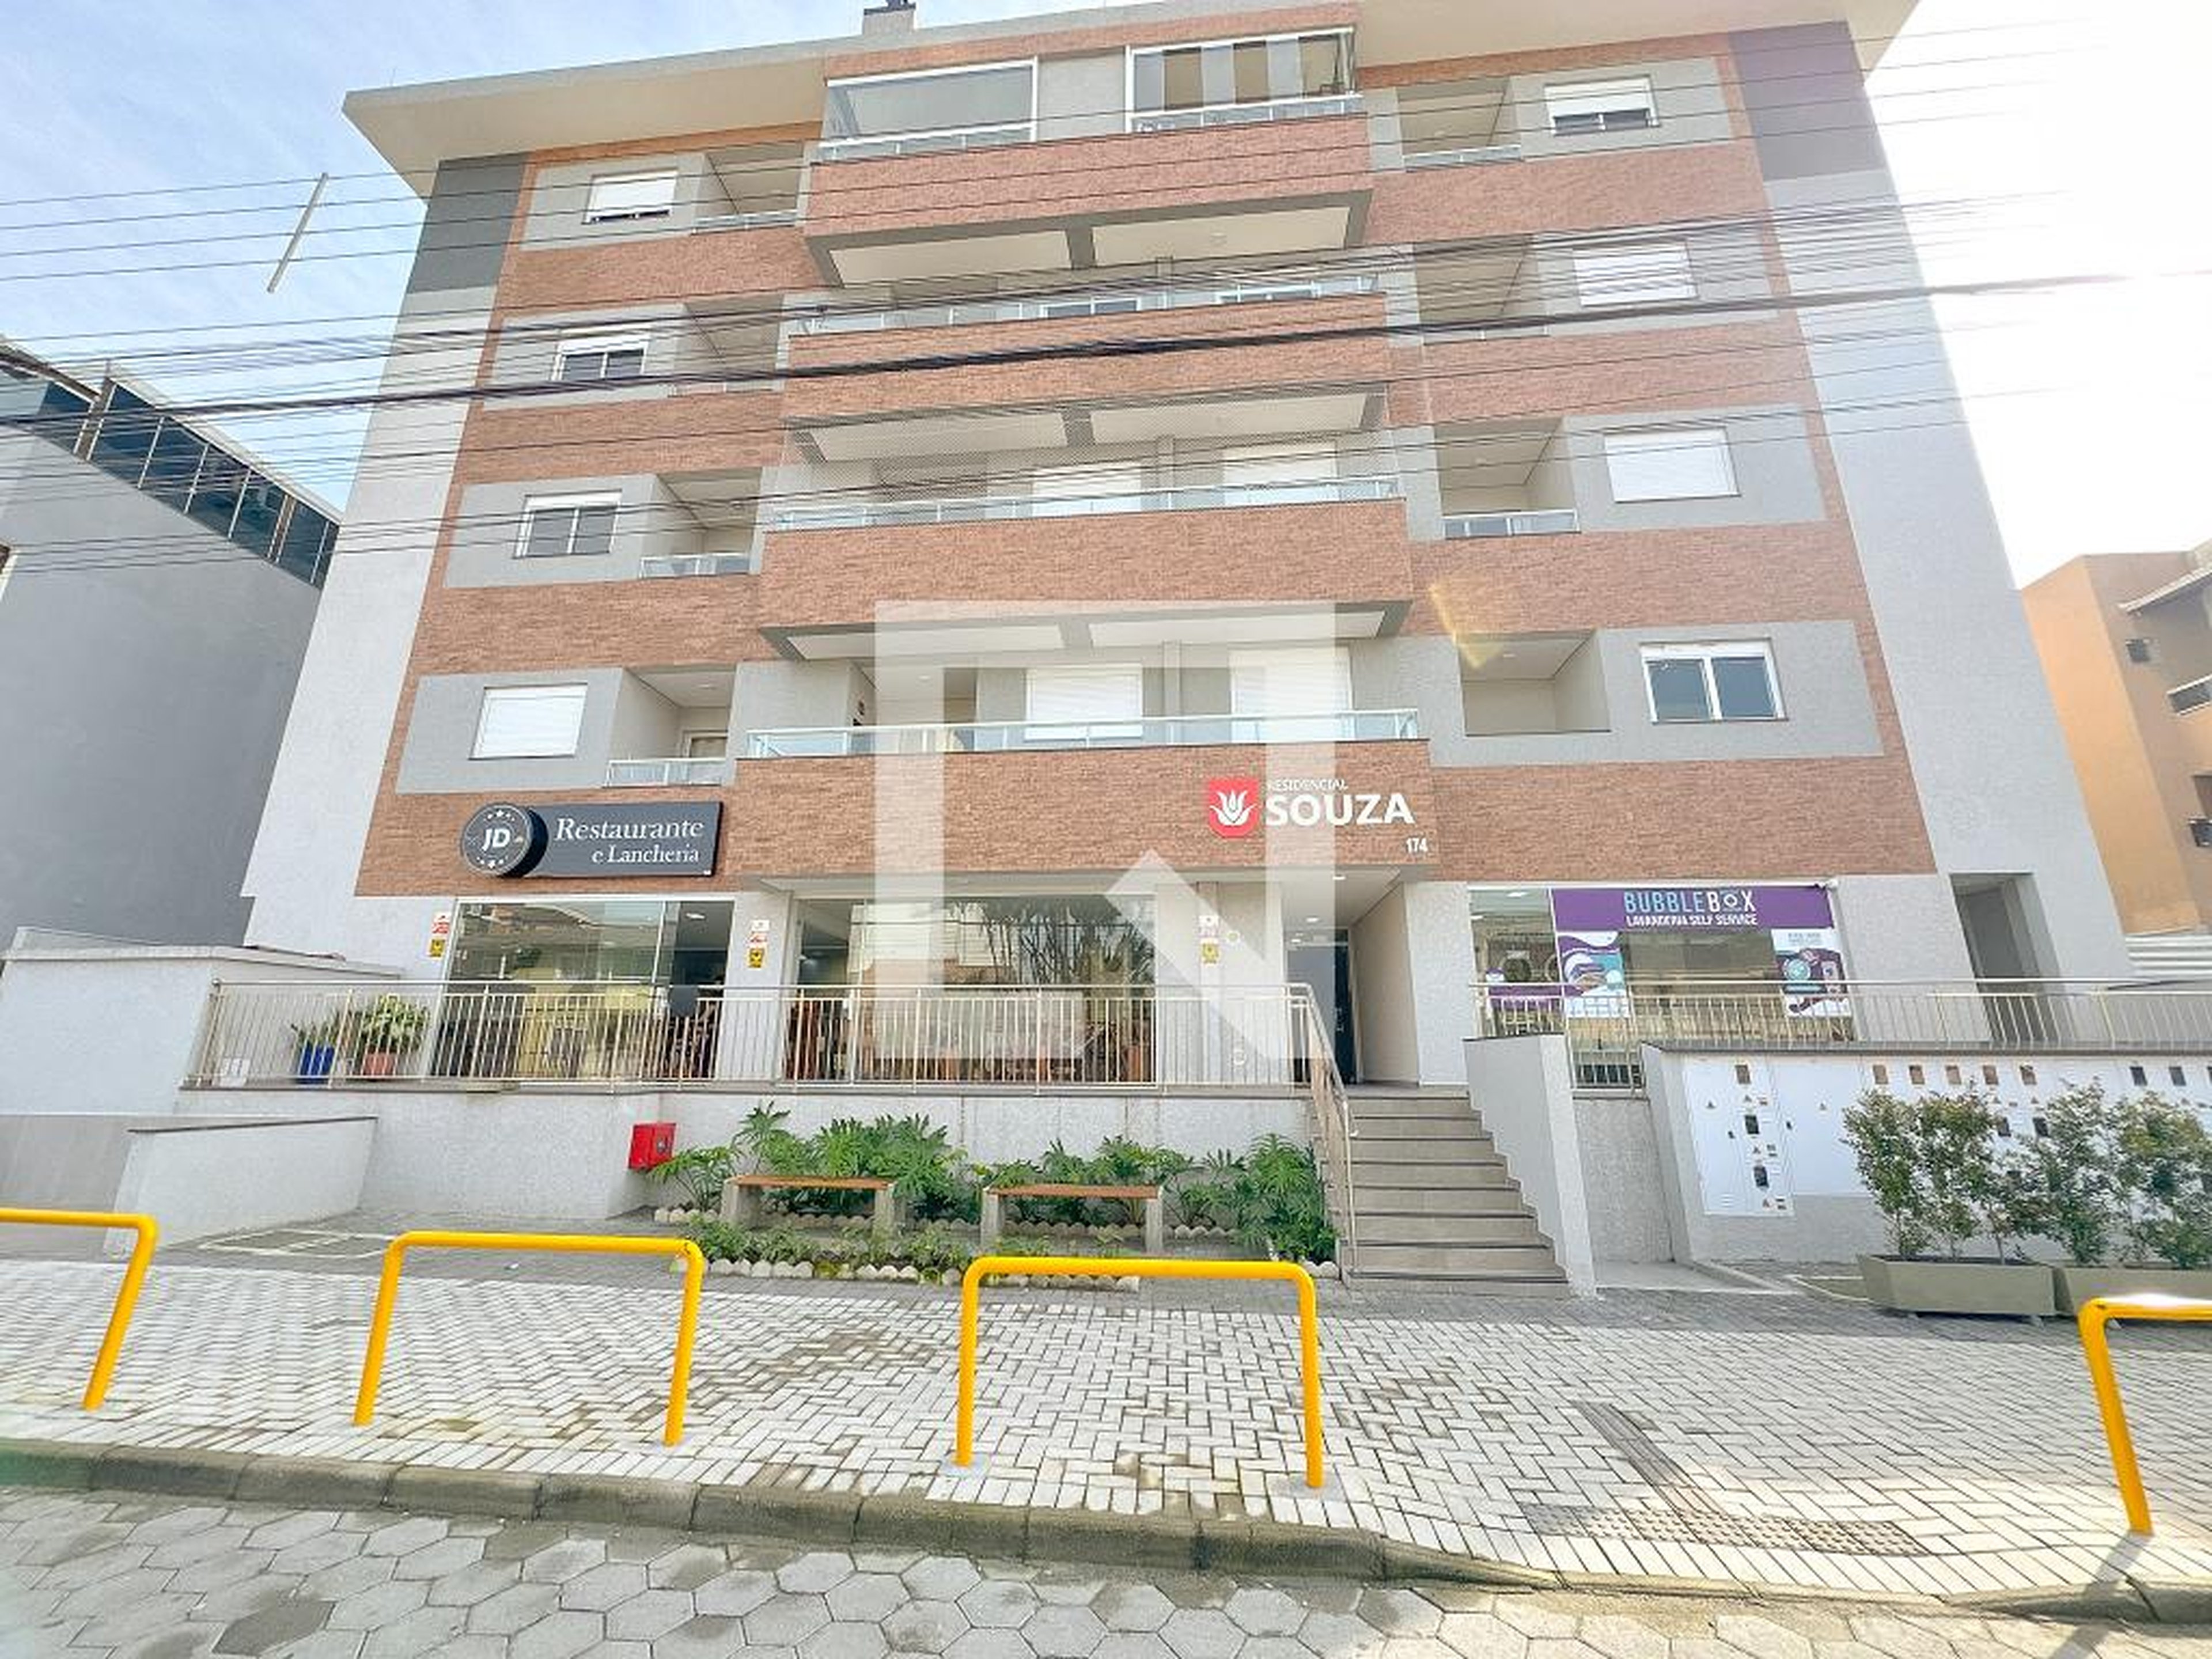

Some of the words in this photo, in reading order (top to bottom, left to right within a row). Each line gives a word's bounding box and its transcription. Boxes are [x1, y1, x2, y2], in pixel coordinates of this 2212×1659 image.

[1266, 793, 1415, 826] SOUZA
[482, 828, 510, 851] JD
[554, 817, 704, 840] Restaurante
[592, 850, 603, 863] e
[607, 843, 699, 863] Lancheria
[1406, 837, 1429, 853] 174
